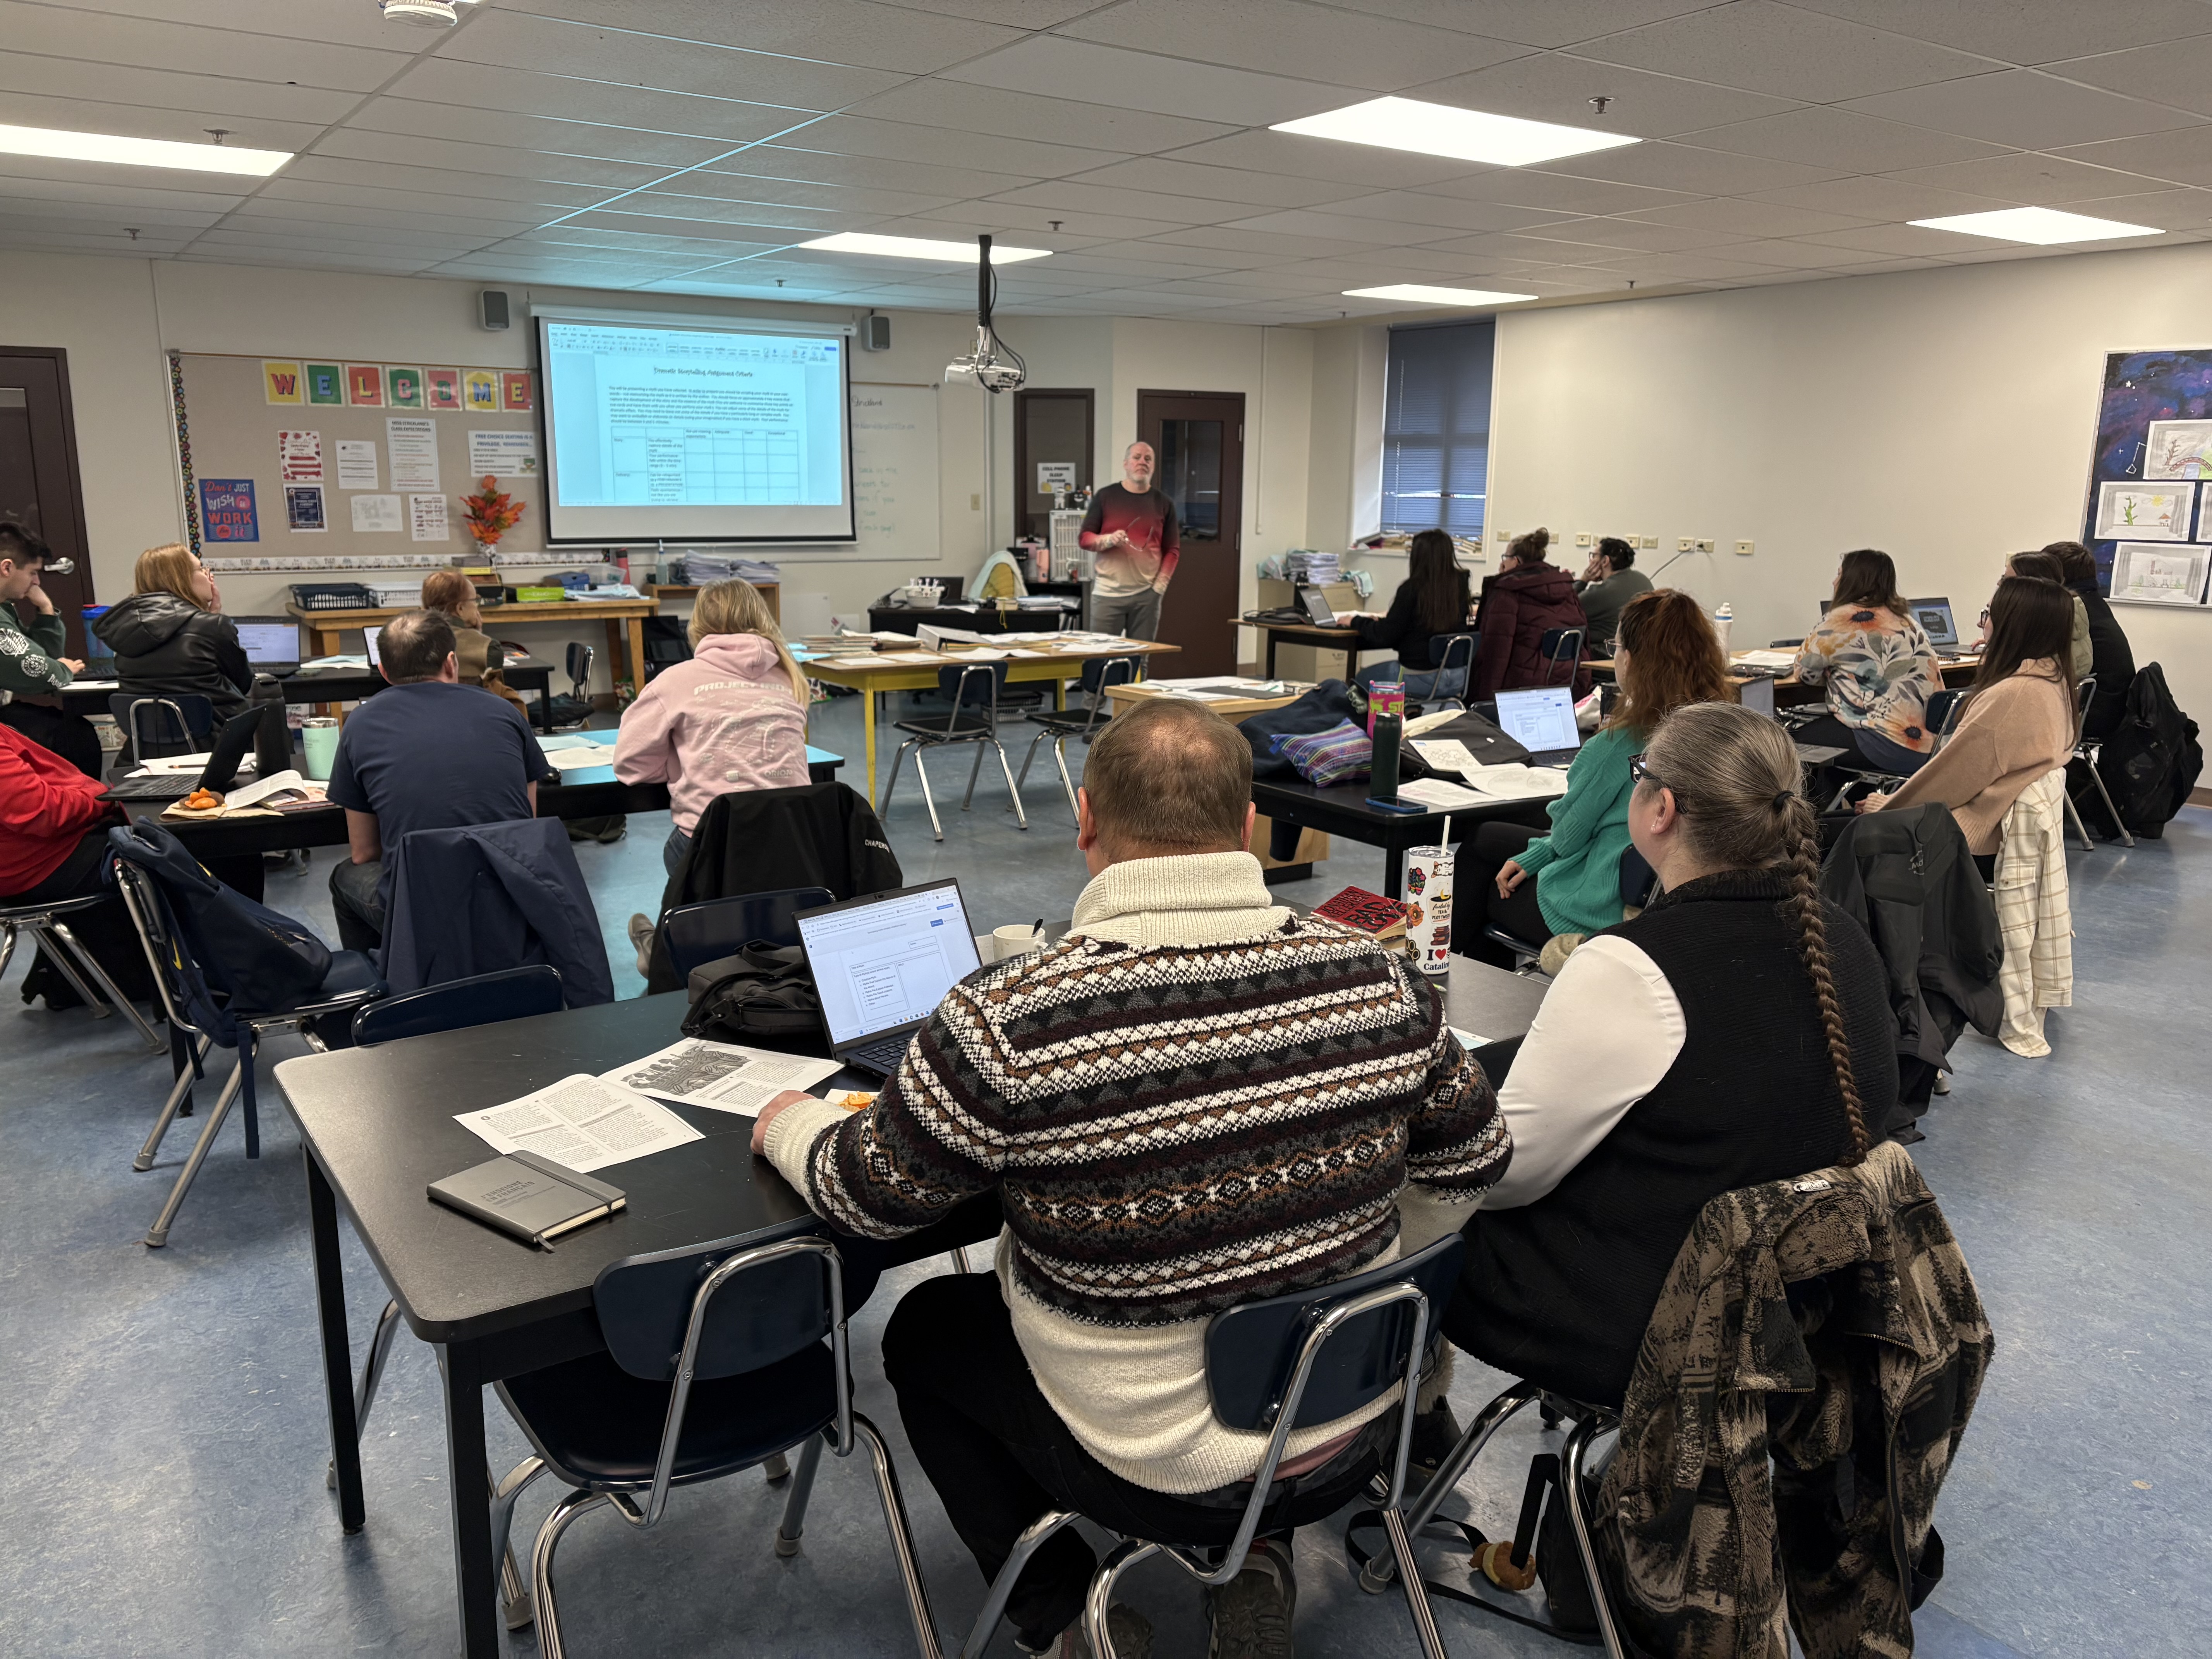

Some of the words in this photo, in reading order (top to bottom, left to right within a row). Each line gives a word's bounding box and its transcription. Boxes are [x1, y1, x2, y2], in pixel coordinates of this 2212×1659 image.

[270, 373, 524, 403] WELCOME
[205, 481, 232, 492] Don't
[234, 483, 250, 492] JUST
[206, 494, 235, 511] WISH
[207, 512, 252, 524] WORK
[235, 525, 245, 538] it
[694, 681, 757, 696] PROJECT
[865, 839, 890, 853] CHAPERO
[1322, 889, 1360, 912] JONATHAN
[1427, 949, 1434, 961] I
[1424, 961, 1450, 970] Catalin
